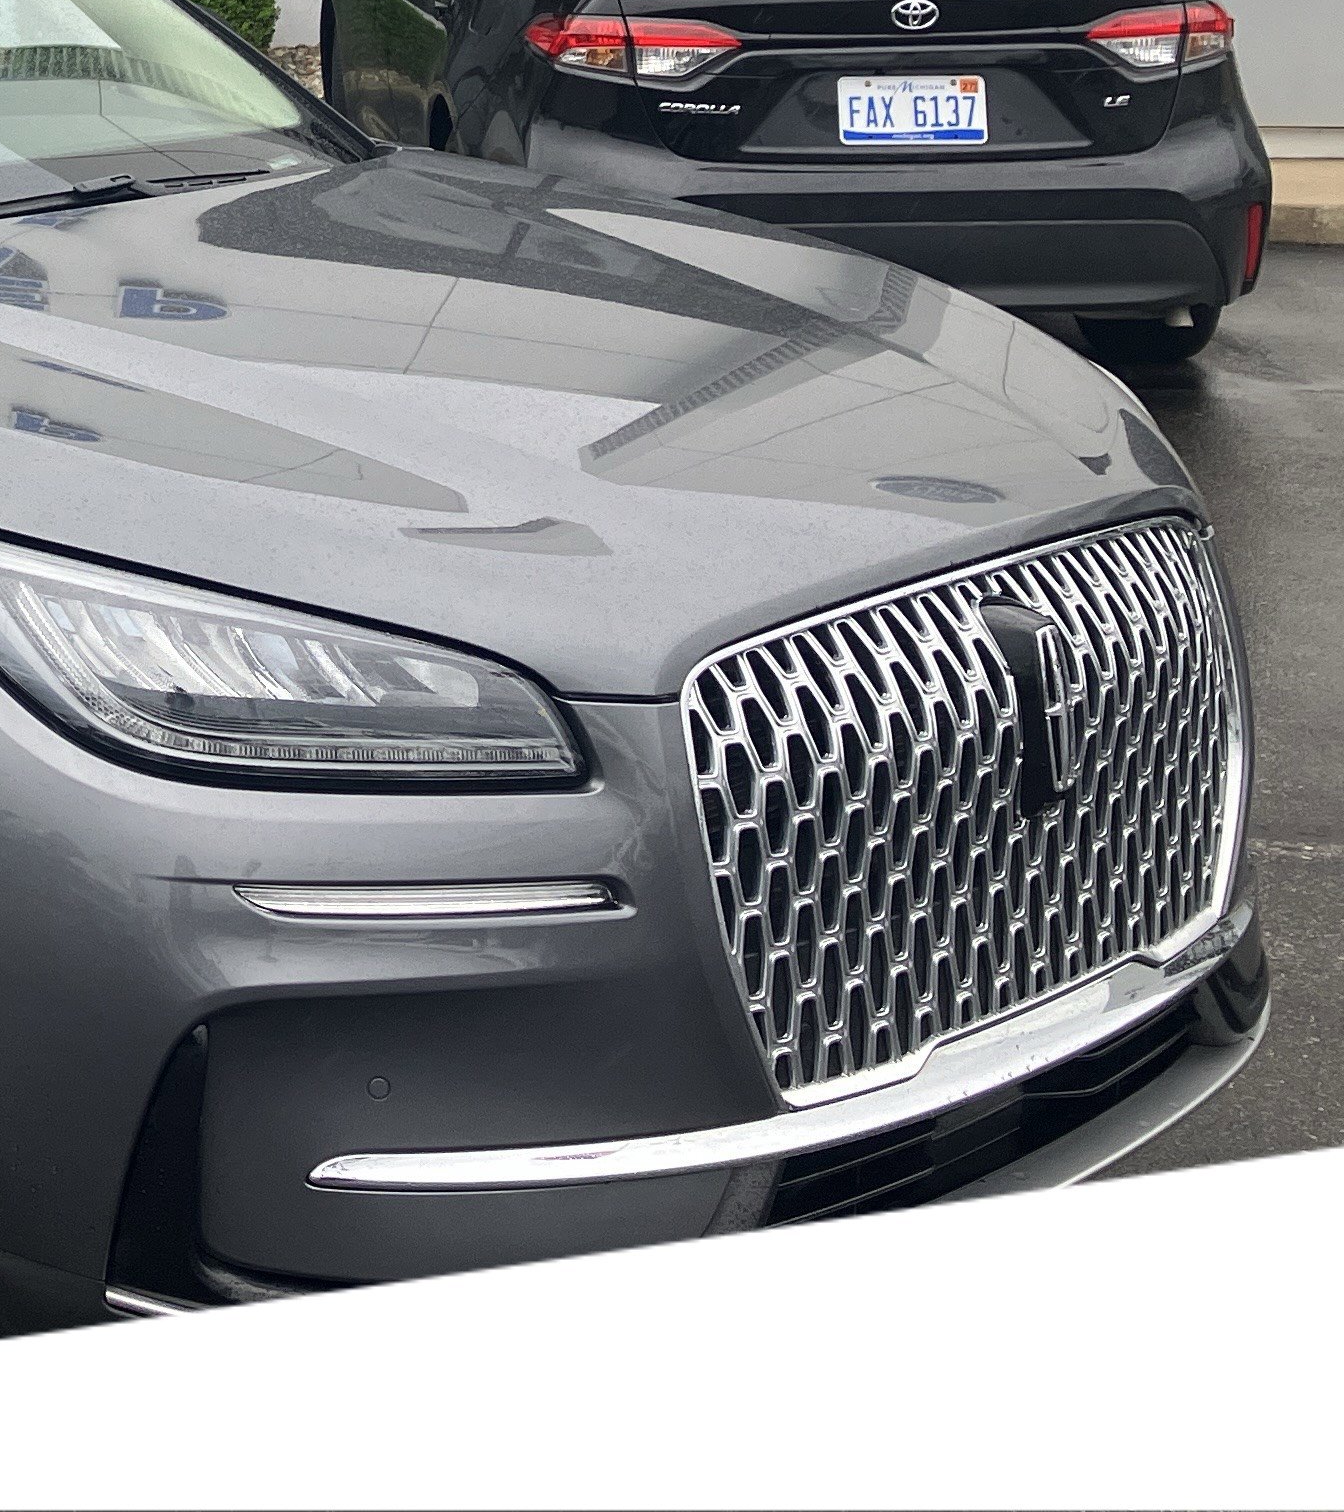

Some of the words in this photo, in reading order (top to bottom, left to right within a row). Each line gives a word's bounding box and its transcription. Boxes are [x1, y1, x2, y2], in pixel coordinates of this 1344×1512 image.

[659, 101, 741, 115] COROLLA
[1103, 94, 1131, 108] LE
[848, 95, 895, 128] FAX
[913, 95, 976, 128] 6137
